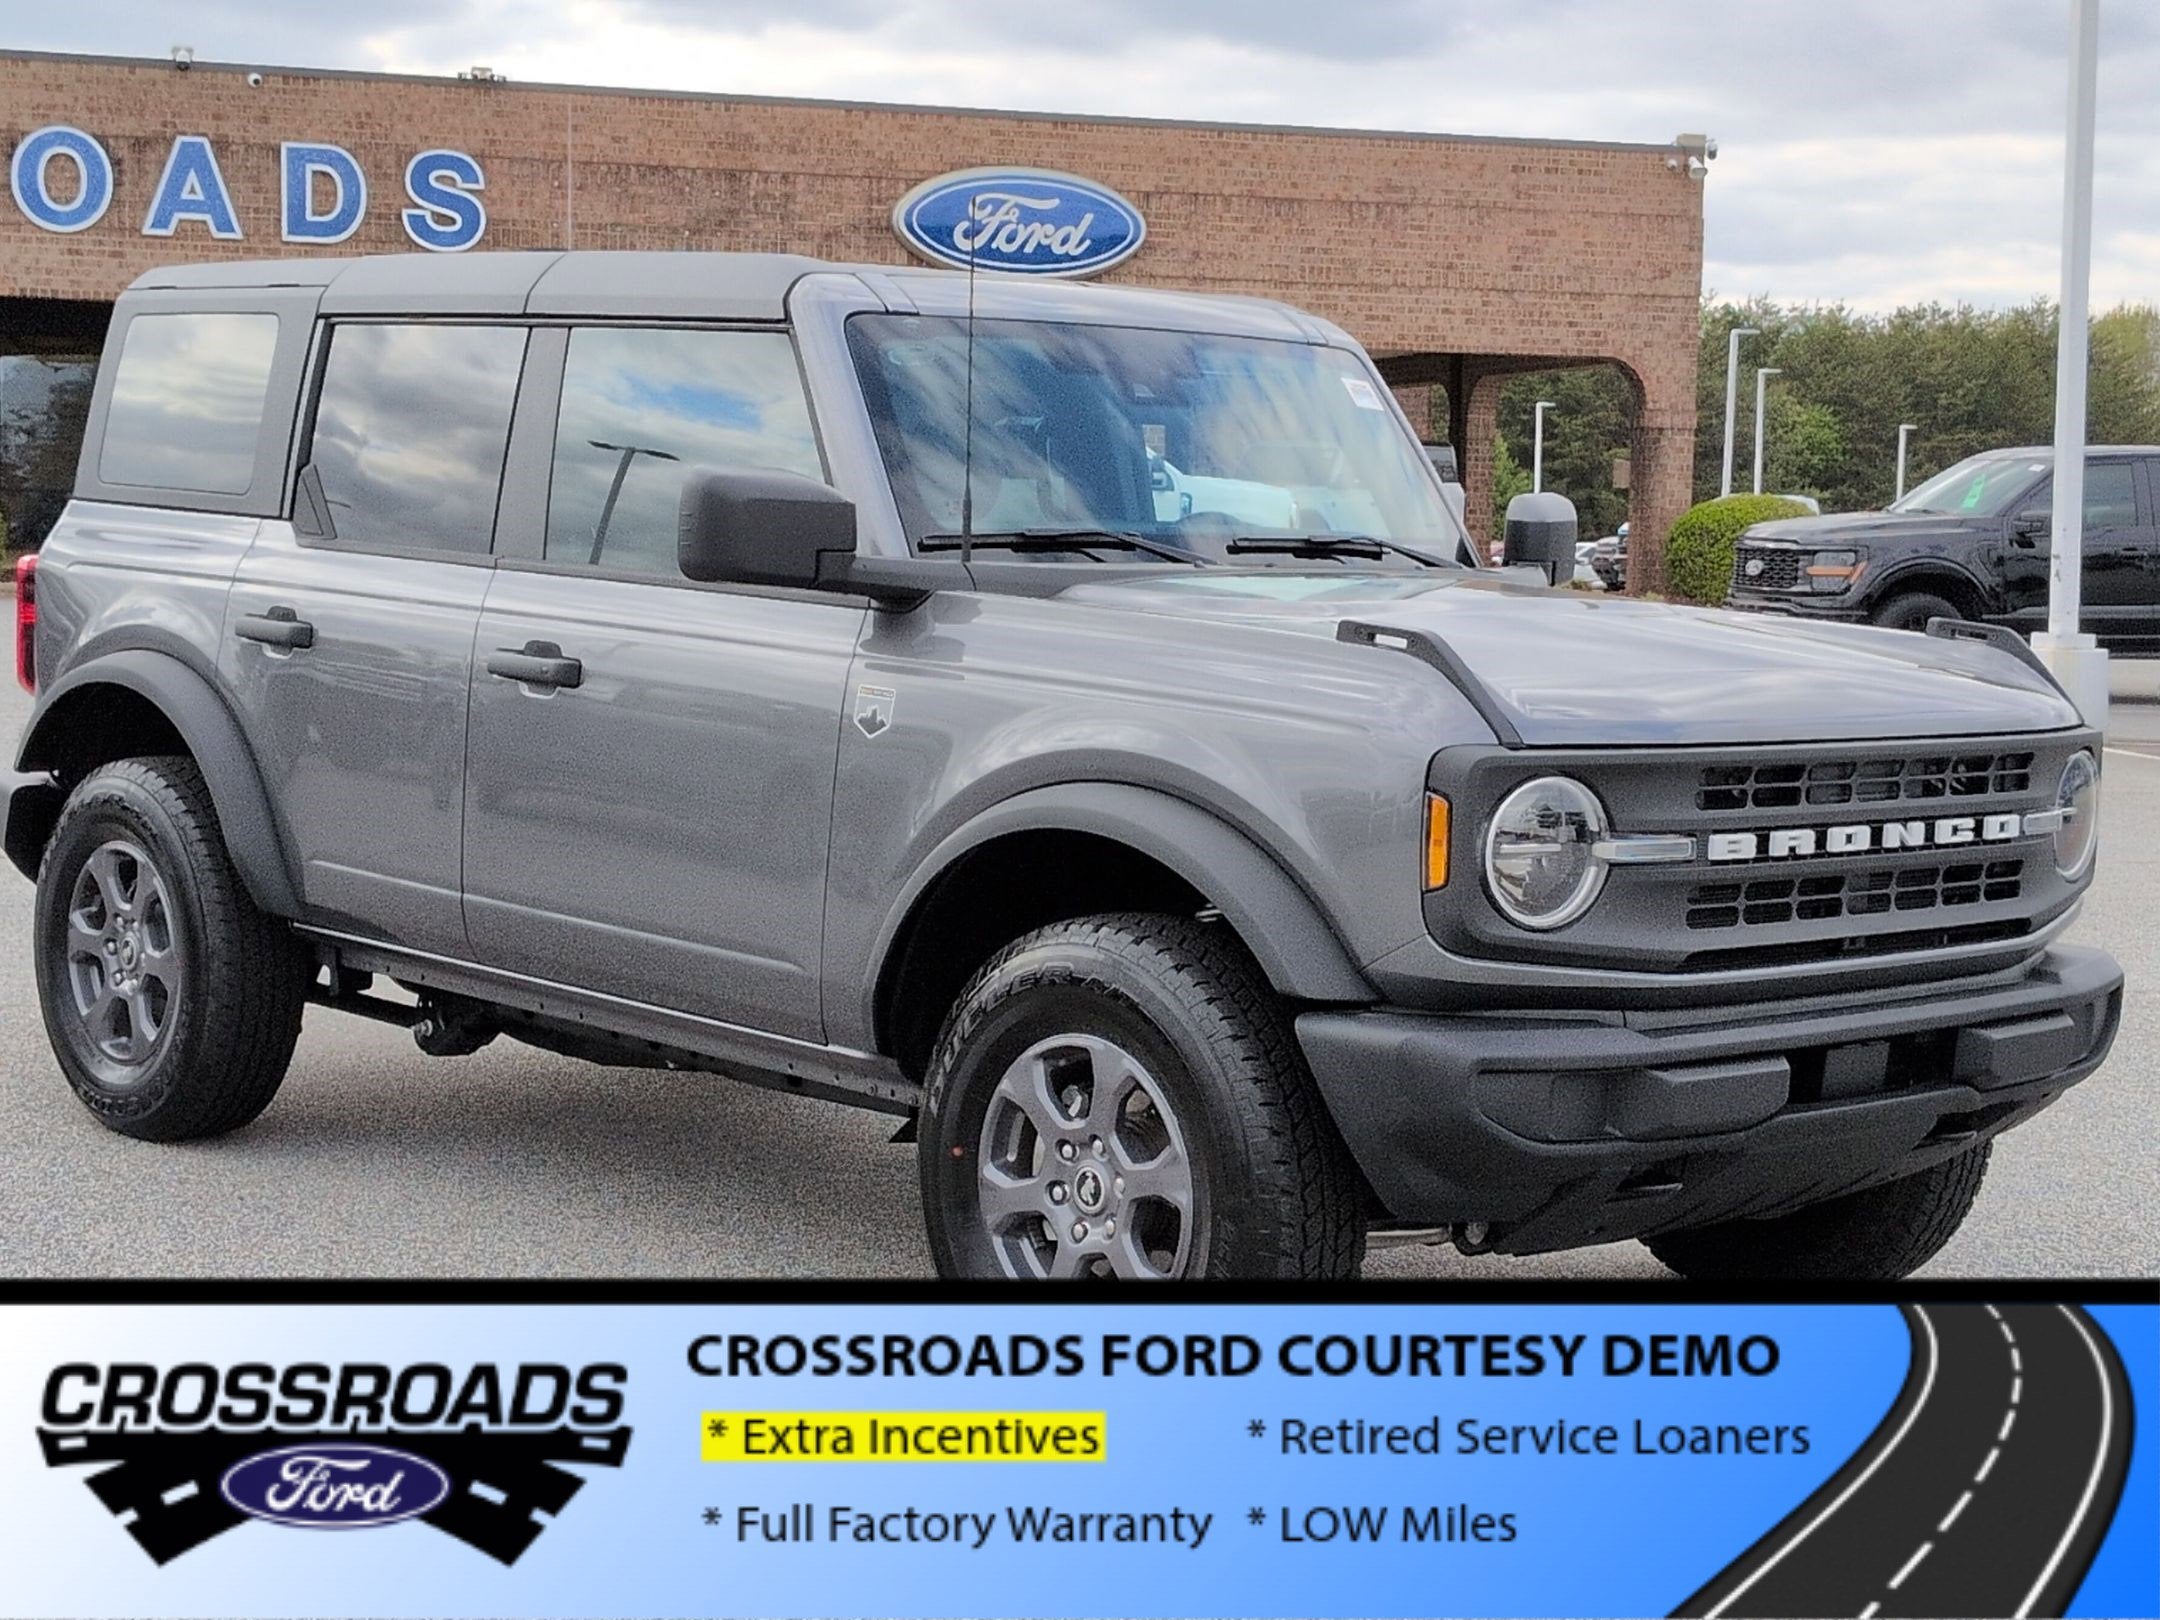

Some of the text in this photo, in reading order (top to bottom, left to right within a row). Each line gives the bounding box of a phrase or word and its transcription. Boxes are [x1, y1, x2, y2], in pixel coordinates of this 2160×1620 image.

[11, 126, 486, 252] OADS
[953, 192, 1094, 256] Ford
[1708, 813, 2021, 861] BRONCO
